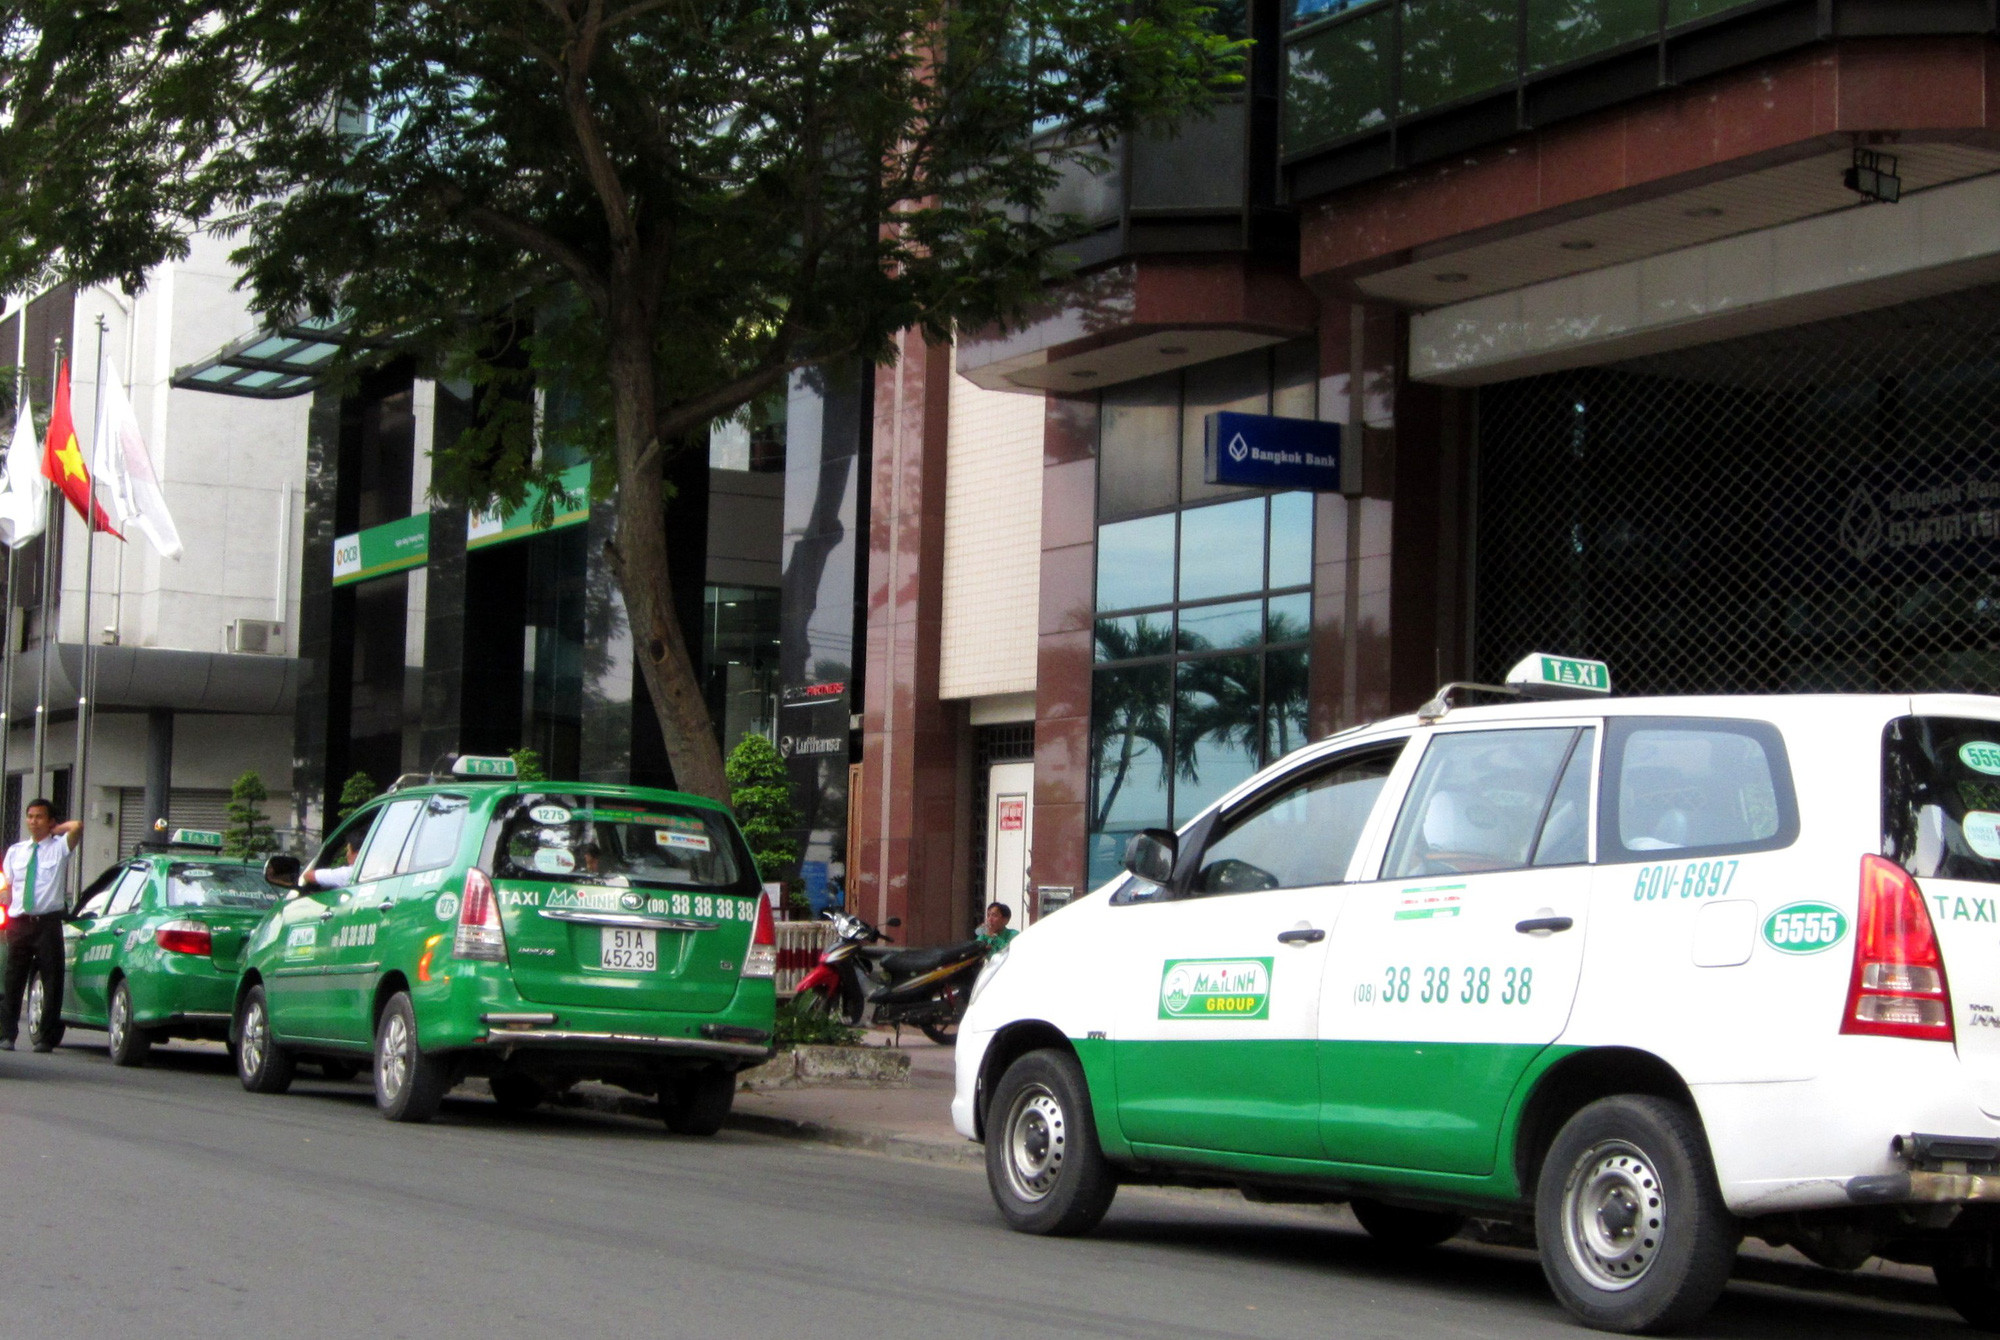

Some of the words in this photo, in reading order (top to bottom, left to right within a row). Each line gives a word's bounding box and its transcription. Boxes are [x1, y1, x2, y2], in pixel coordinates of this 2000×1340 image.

[1251, 447, 1302, 464] Bangkok
[1305, 453, 1336, 468] Bank
[342, 545, 358, 564] OCB
[538, 808, 565, 821] 1275
[1633, 860, 1739, 901] 60V-6897
[499, 890, 539, 905] TAXI
[647, 899, 669, 915] (08)
[672, 894, 690, 916] 38
[694, 895, 712, 918] 38
[716, 897, 734, 920] 38
[737, 900, 754, 922] 38
[1933, 896, 1997, 923] TAXI
[1773, 912, 1838, 944] 5555
[614, 930, 644, 950] 51A
[603, 950, 655, 969] 452.39
[1354, 984, 1376, 1006] (08)
[1382, 966, 1410, 1003] 38
[1421, 966, 1450, 1004] 38
[1461, 966, 1491, 1004] 38
[1502, 966, 1532, 1005] 38
[1206, 997, 1255, 1012] GROUP
